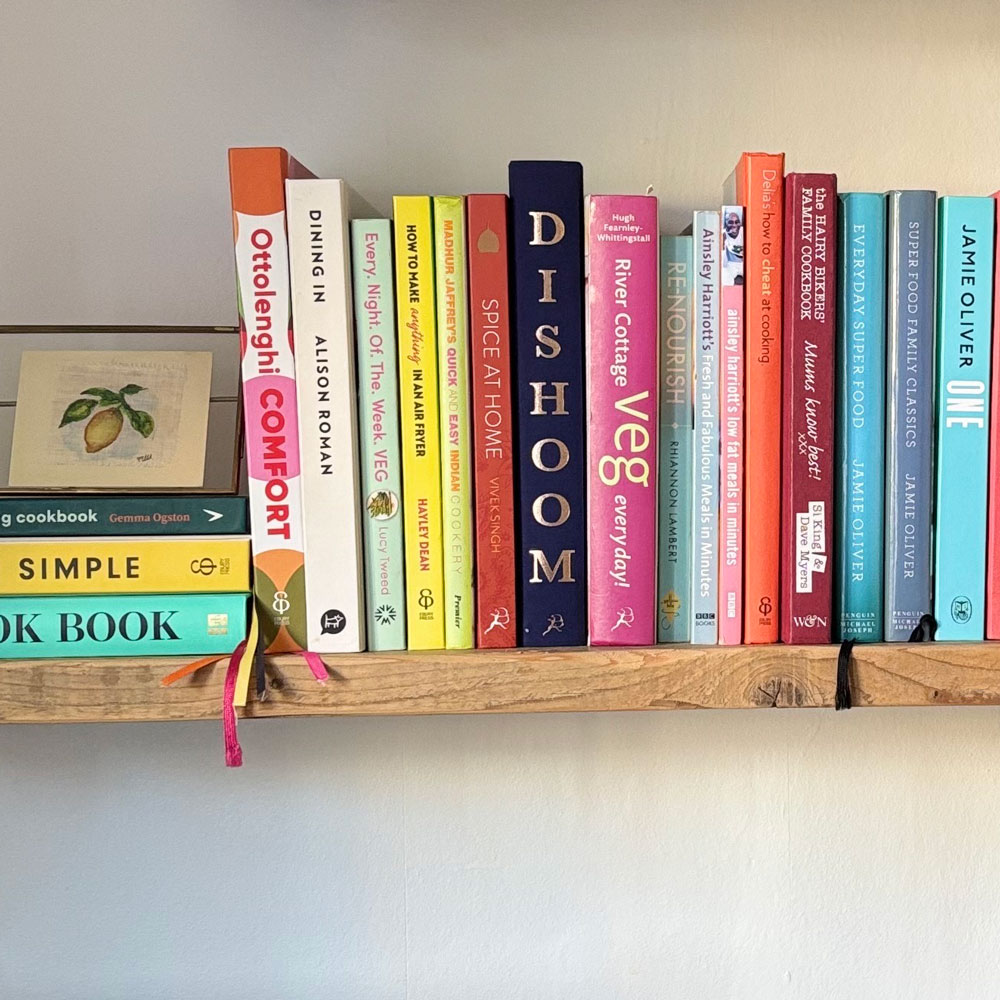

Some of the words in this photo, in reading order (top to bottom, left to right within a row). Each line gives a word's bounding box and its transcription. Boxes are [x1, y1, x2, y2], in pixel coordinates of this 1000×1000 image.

[762, 169, 777, 209] Delia's
[816, 188, 826, 210] the
[406, 224, 417, 253] HOW
[596, 233, 651, 243] Whittingstall
[603, 223, 643, 233] Fearnley-
[612, 213, 635, 223] Hugh
[801, 188, 813, 243] FAMILY
[815, 215, 826, 262] HAIRY
[309, 210, 325, 277] DINING
[364, 233, 379, 279] Every.
[443, 220, 454, 274] MADHUR
[699, 228, 714, 279] Ainsley
[908, 221, 919, 268] SUPER
[962, 224, 976, 286] JAMIE
[409, 272, 420, 303] MAKE
[615, 259, 631, 308] River
[762, 258, 775, 296] cheat
[800, 246, 812, 321] COOKBOOK
[853, 224, 865, 316] EVERYDAY
[907, 272, 919, 314] FOOD
[250, 228, 281, 374] Ottolenghi
[313, 285, 326, 303] IN
[364, 285, 381, 330] Night.
[445, 279, 457, 344] JAFFREY'S
[702, 283, 714, 351] Harriott's
[482, 299, 500, 358] SPICE
[610, 313, 631, 387] Cottage
[666, 262, 687, 403] RE-NOURISH
[725, 309, 738, 352] ainsley
[853, 322, 865, 375] SUPER
[907, 318, 918, 373] FAMILY
[959, 292, 975, 368] OLIVER
[315, 336, 331, 401] ALISON
[370, 364, 385, 395] The.
[447, 348, 458, 387] QUICK
[483, 364, 501, 388] AT
[702, 355, 714, 390] Fresh
[727, 357, 740, 413] harriott's
[414, 402, 424, 421] AIR
[528, 211, 575, 583] DISHOOM
[701, 393, 714, 418] and
[853, 380, 865, 428] FOOD
[905, 378, 917, 448] CLASSICS
[946, 380, 986, 428] ONE
[318, 410, 333, 475] ROMAN
[372, 399, 387, 445] Week.
[414, 424, 426, 457] FRYER
[448, 414, 459, 446] EASY
[484, 394, 503, 459] HOME
[727, 416, 739, 439] low
[259, 388, 291, 540] COMFORT
[373, 449, 388, 483] VEG
[450, 449, 460, 492] INDIAN
[701, 420, 714, 481] Fabulous
[669, 441, 679, 508] RHIANNON
[727, 462, 740, 497] meals
[852, 460, 864, 513] JAMIE
[904, 473, 915, 519] JAMIE
[16, 508, 98, 524] cookbook
[108, 512, 150, 523] Gemma
[152, 511, 190, 525] Ogston
[417, 498, 429, 540] HAYLEY
[701, 484, 713, 522] Meals
[377, 526, 389, 554] Lucy
[451, 495, 462, 575] COOKERY
[668, 513, 678, 563] LAMBERT
[726, 517, 739, 566] minutes
[800, 517, 809, 546] Dave
[852, 519, 864, 582] OLIVER
[904, 524, 915, 579] OLIVER
[18, 556, 140, 580] SIMPLE
[379, 556, 391, 595] Tweed
[420, 543, 430, 571] DEAN
[700, 541, 712, 598] Minutes
[798, 551, 809, 589] Myers
[56, 610, 183, 643] BOOK
